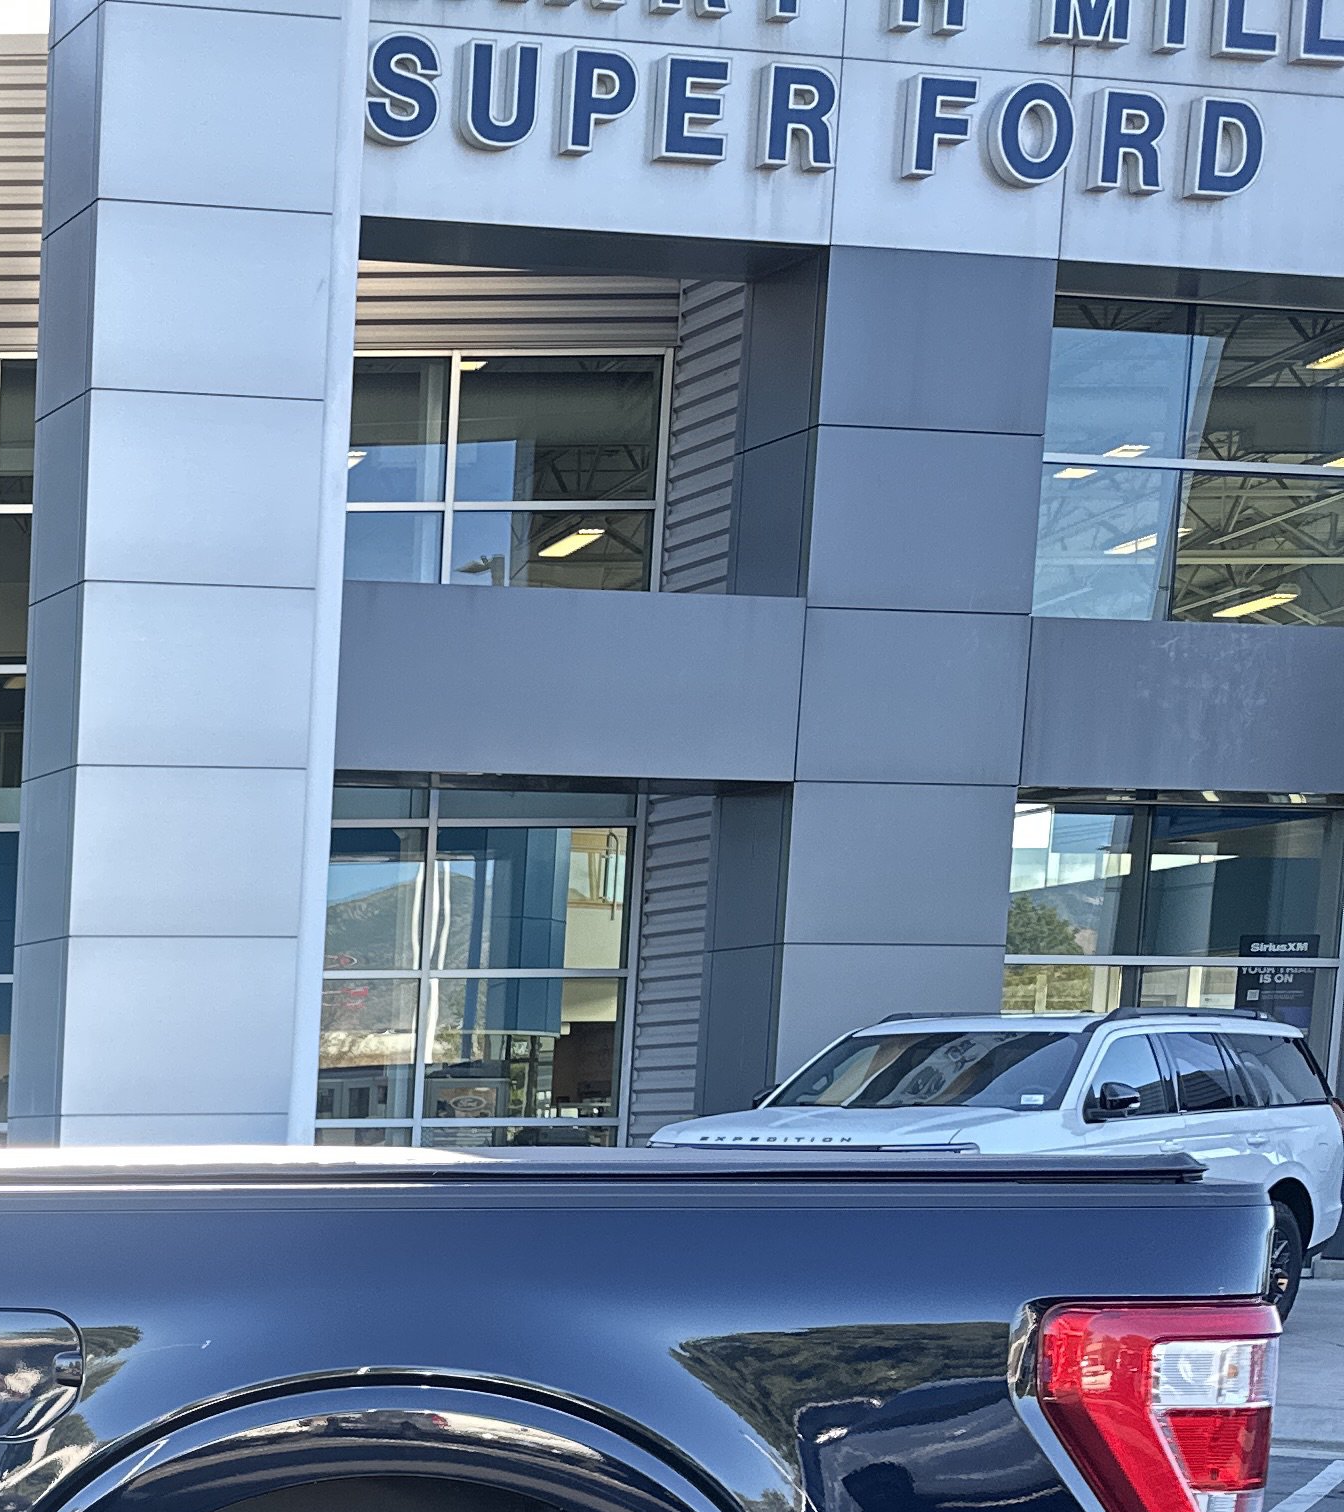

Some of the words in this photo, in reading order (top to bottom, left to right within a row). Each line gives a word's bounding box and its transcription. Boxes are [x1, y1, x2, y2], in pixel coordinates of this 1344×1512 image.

[365, 30, 839, 172] SUPER
[902, 72, 1266, 200] FORD
[1250, 942, 1309, 952] SiriusXM
[1259, 974, 1272, 983] IS
[1274, 974, 1294, 983] ON
